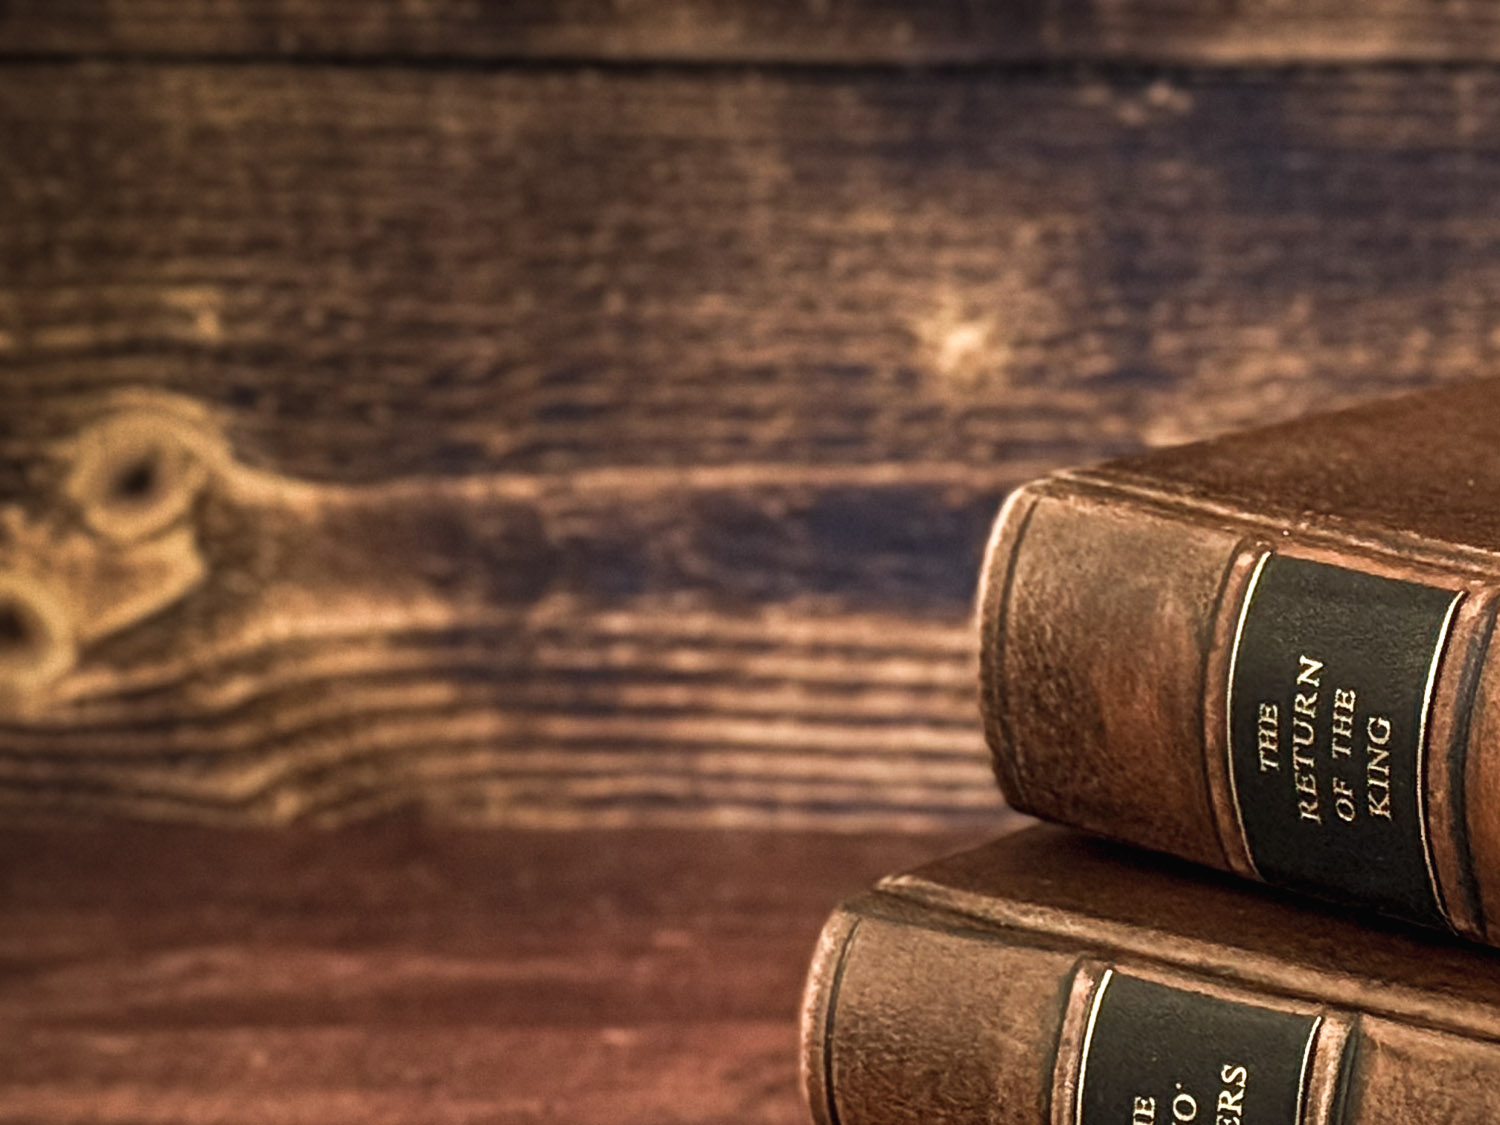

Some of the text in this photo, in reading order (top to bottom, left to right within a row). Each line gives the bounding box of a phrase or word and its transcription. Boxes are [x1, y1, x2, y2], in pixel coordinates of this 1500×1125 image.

[1258, 703, 1280, 772] THE
[1294, 655, 1323, 825] RETURN
[1332, 688, 1355, 822] OF THE
[1367, 716, 1391, 821] KING
